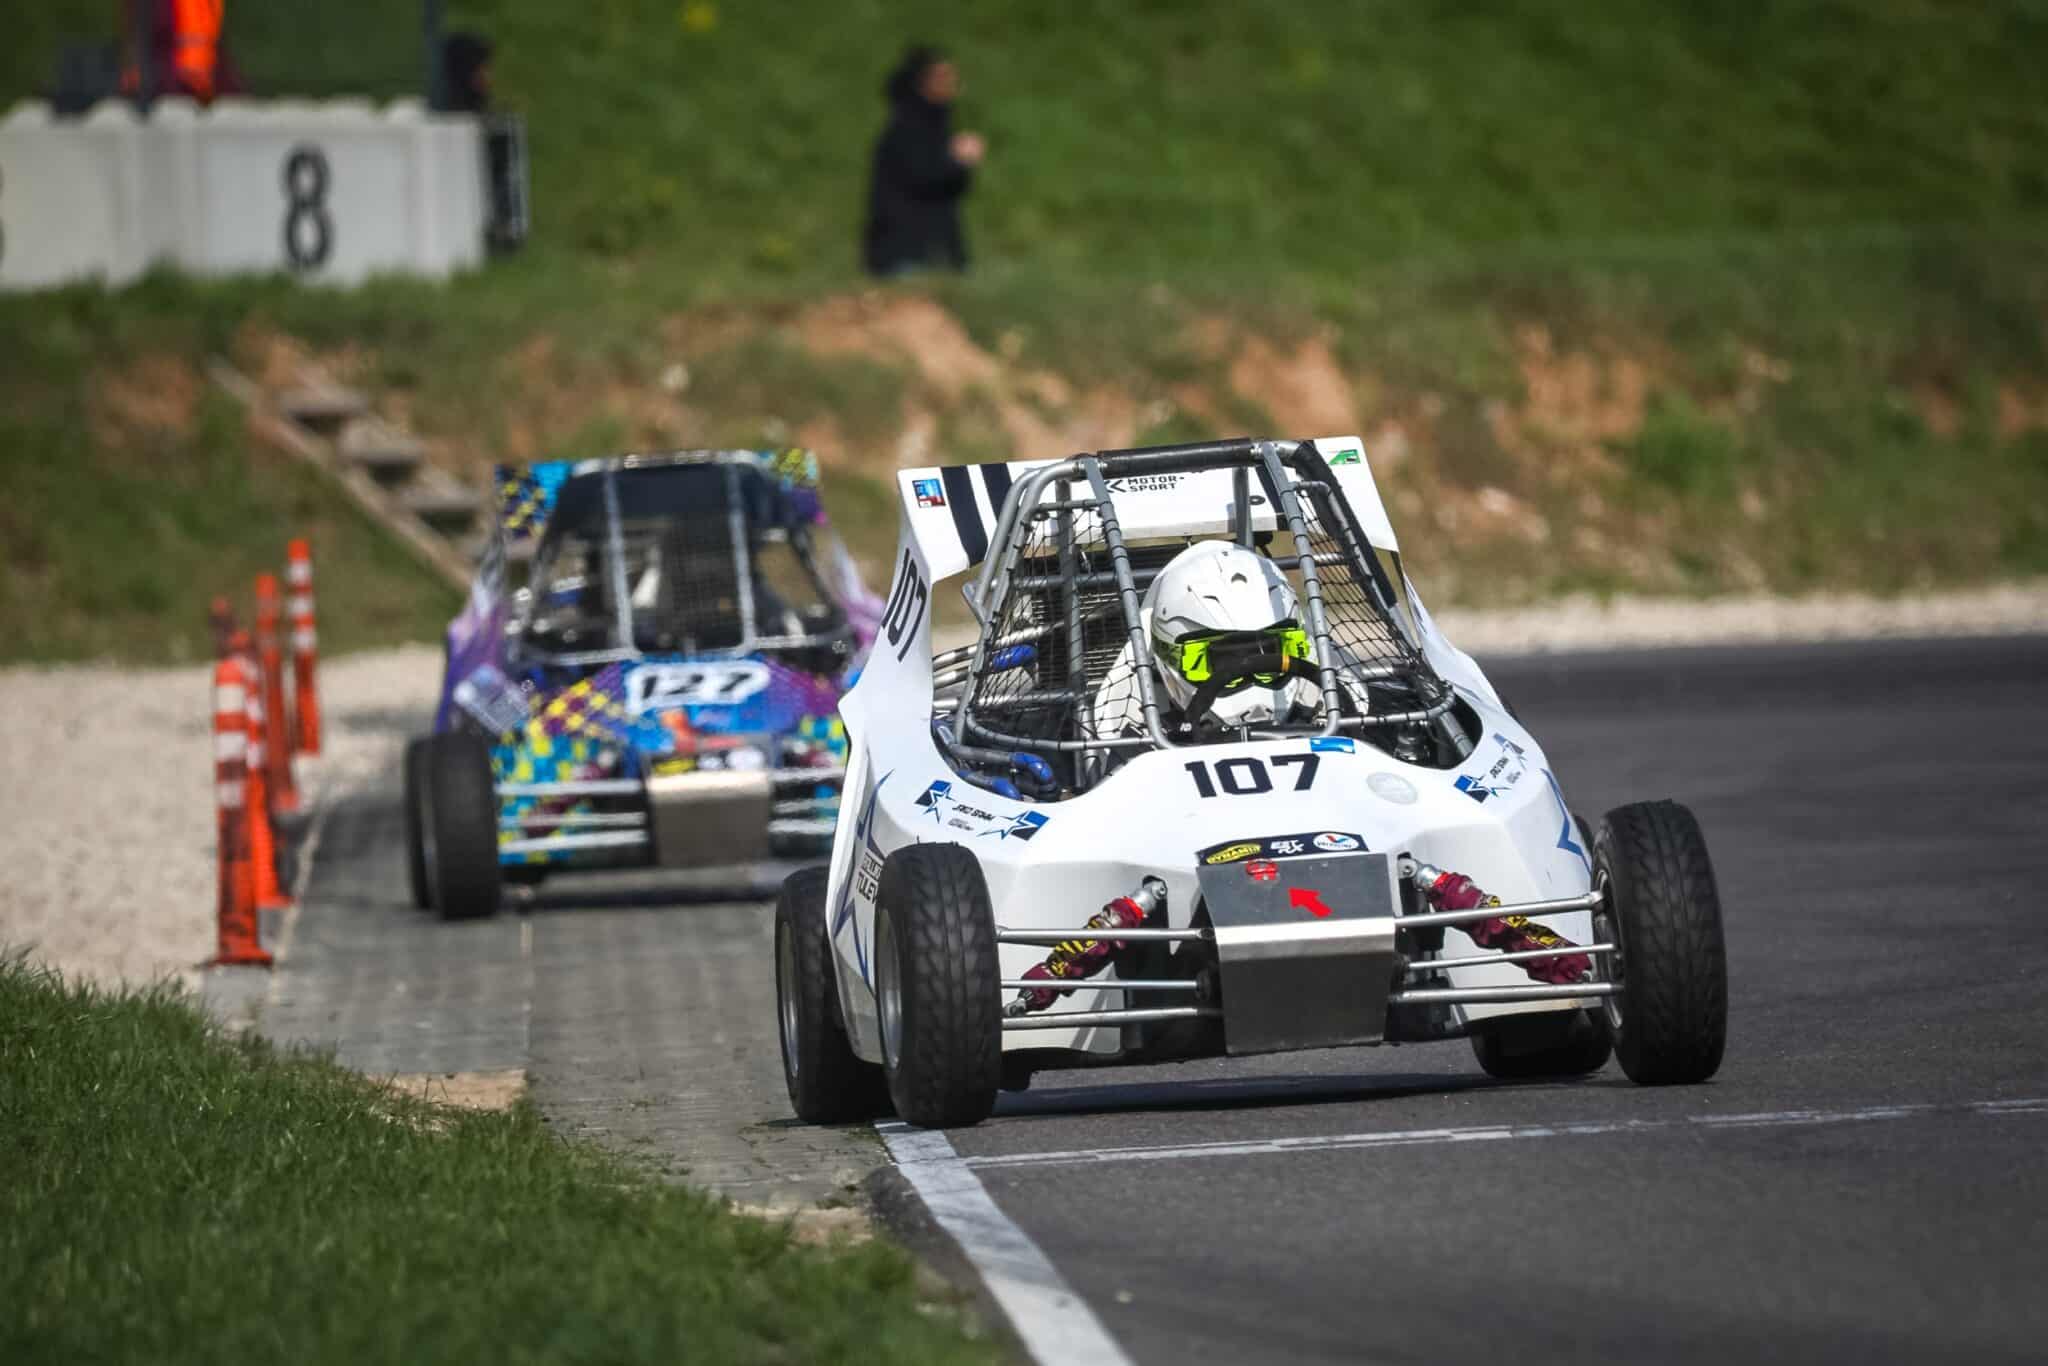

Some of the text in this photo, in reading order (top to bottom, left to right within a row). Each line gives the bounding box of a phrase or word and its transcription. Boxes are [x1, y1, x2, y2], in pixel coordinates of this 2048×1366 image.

[282, 144, 336, 270] 8
[1127, 475, 1185, 485] MOTOR-
[1129, 482, 1176, 493] SPORT
[880, 546, 928, 663] 107
[641, 671, 752, 700] 127
[1184, 752, 1321, 799] 107
